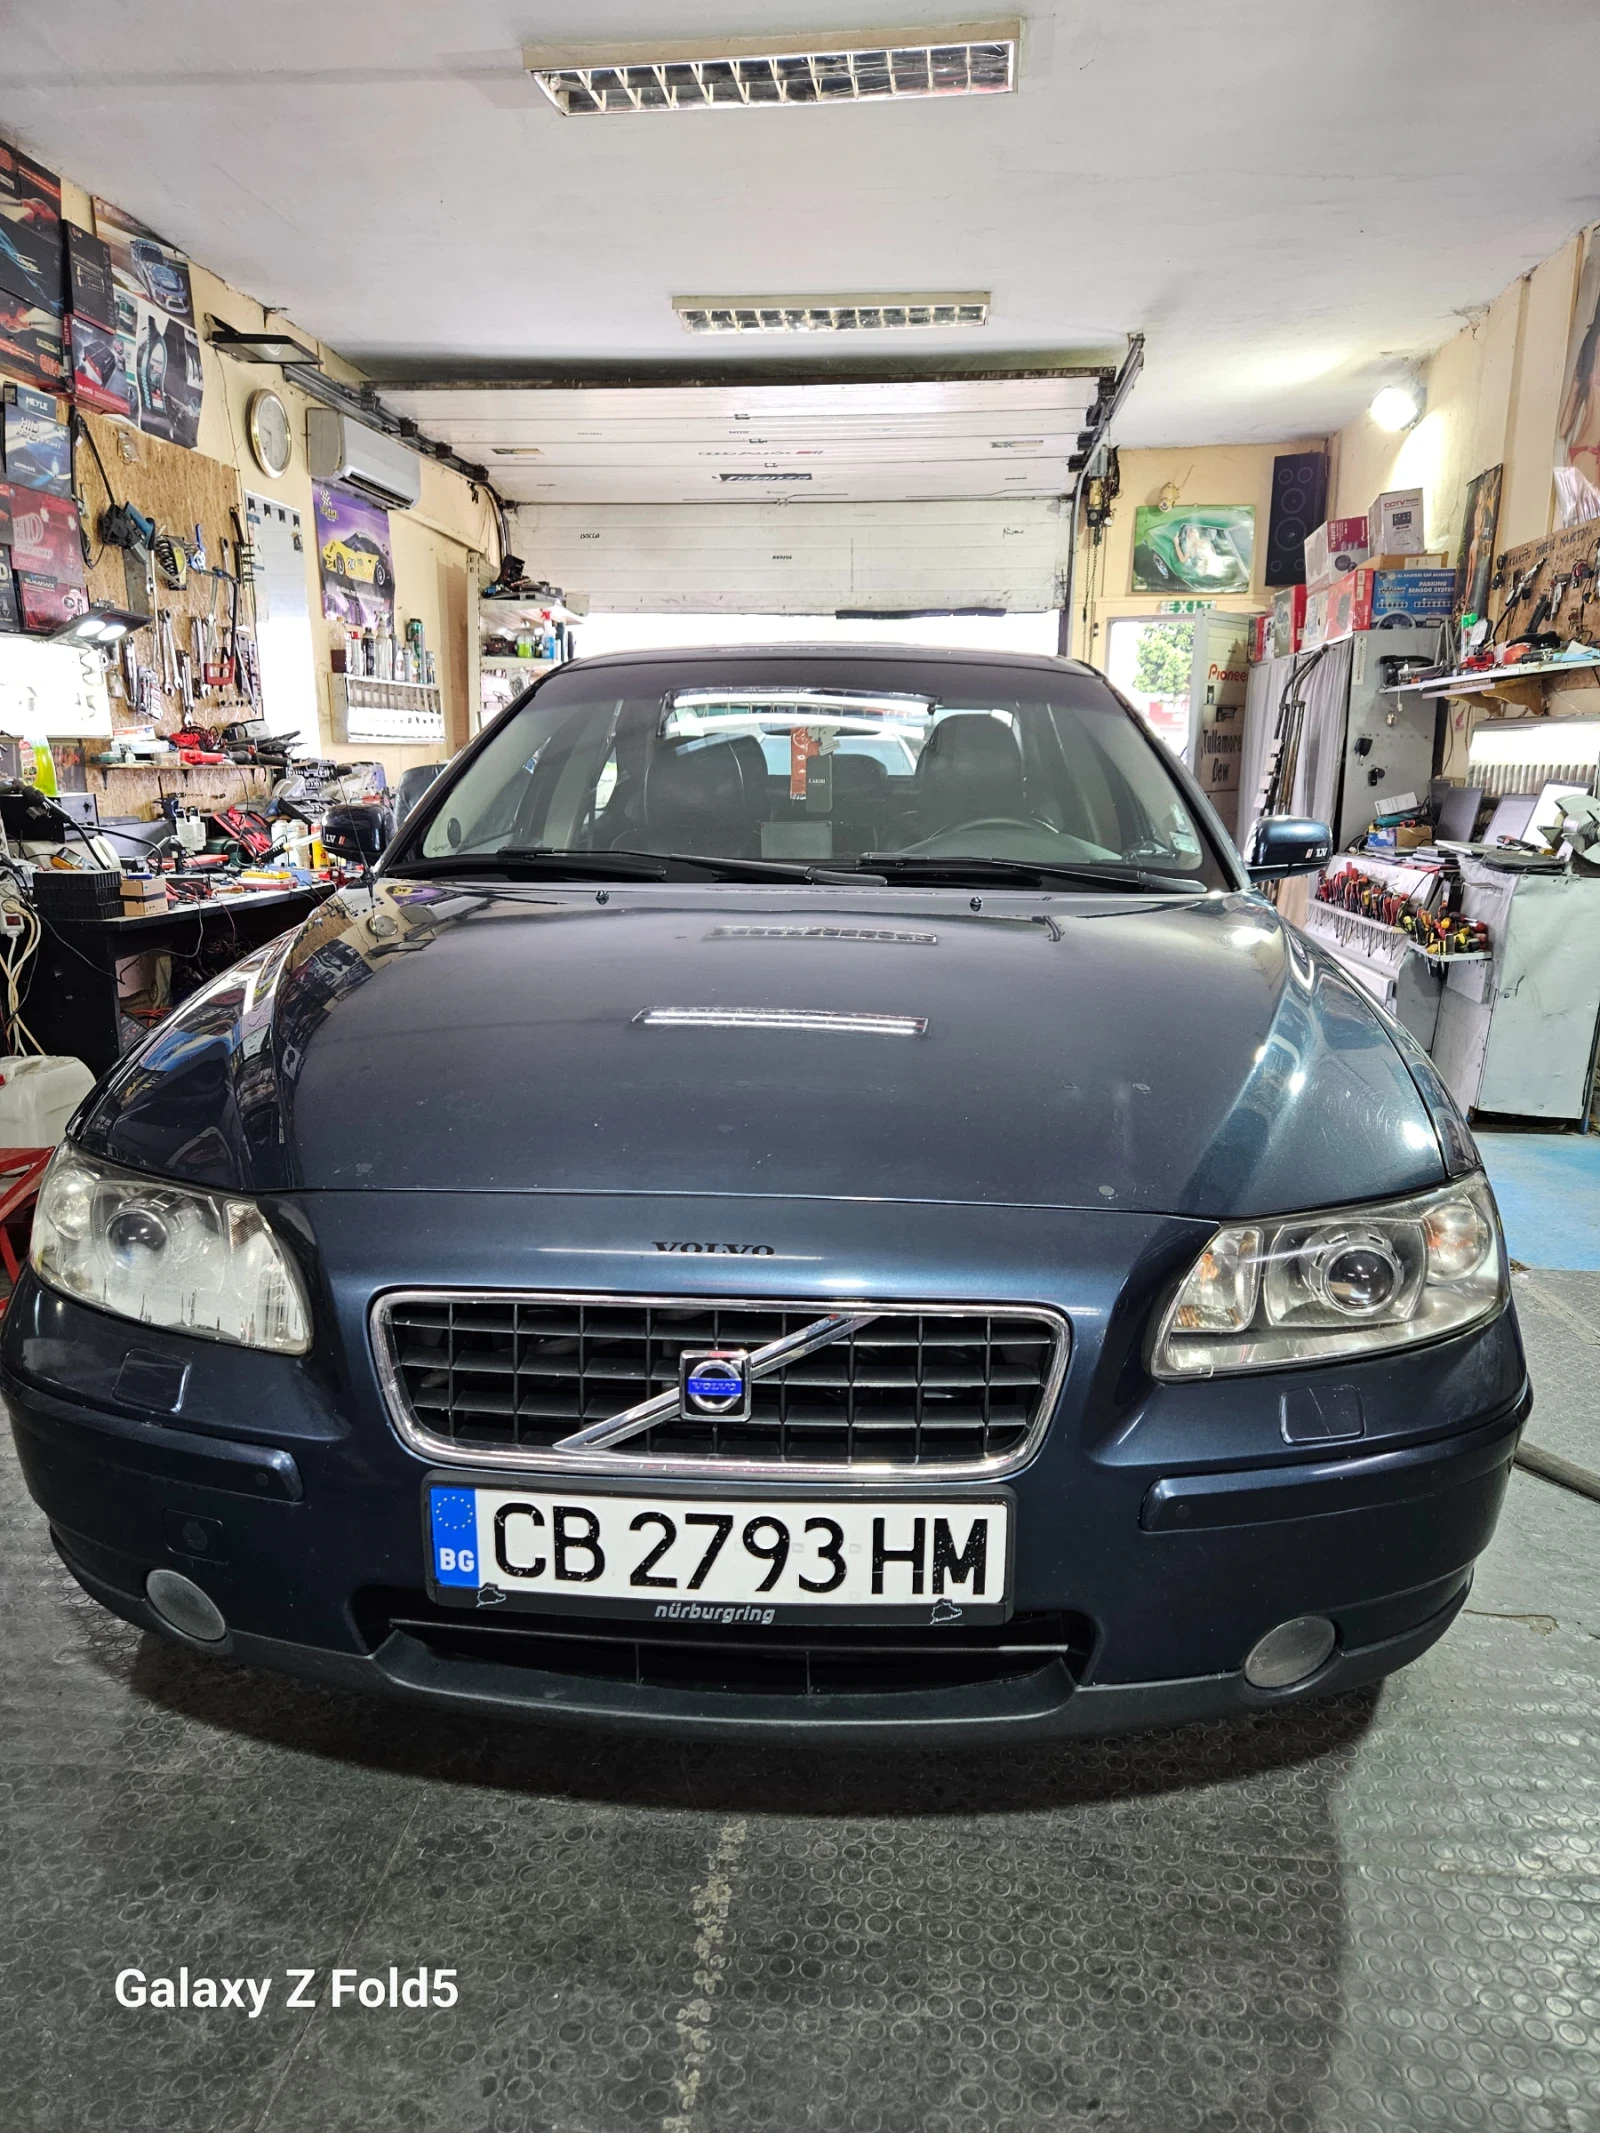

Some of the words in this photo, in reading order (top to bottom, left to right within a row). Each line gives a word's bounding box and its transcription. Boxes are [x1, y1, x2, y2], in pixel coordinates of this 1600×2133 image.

[72, 318, 93, 333] Pioneer
[25, 396, 49, 411] MEYLE
[1385, 500, 1406, 508] CCTV
[1168, 601, 1211, 614] EXIT
[1212, 758, 1230, 783] Dew
[325, 834, 337, 843] LV
[1316, 847, 1328, 857] LV
[652, 1241, 775, 1256] VOLVO
[692, 1381, 737, 1391] VOLVO
[494, 1501, 605, 1583] CB
[629, 1511, 848, 1595] 2793
[870, 1517, 988, 1595] HM
[440, 1546, 475, 1573] BG
[655, 1603, 775, 1625] nürburgring
